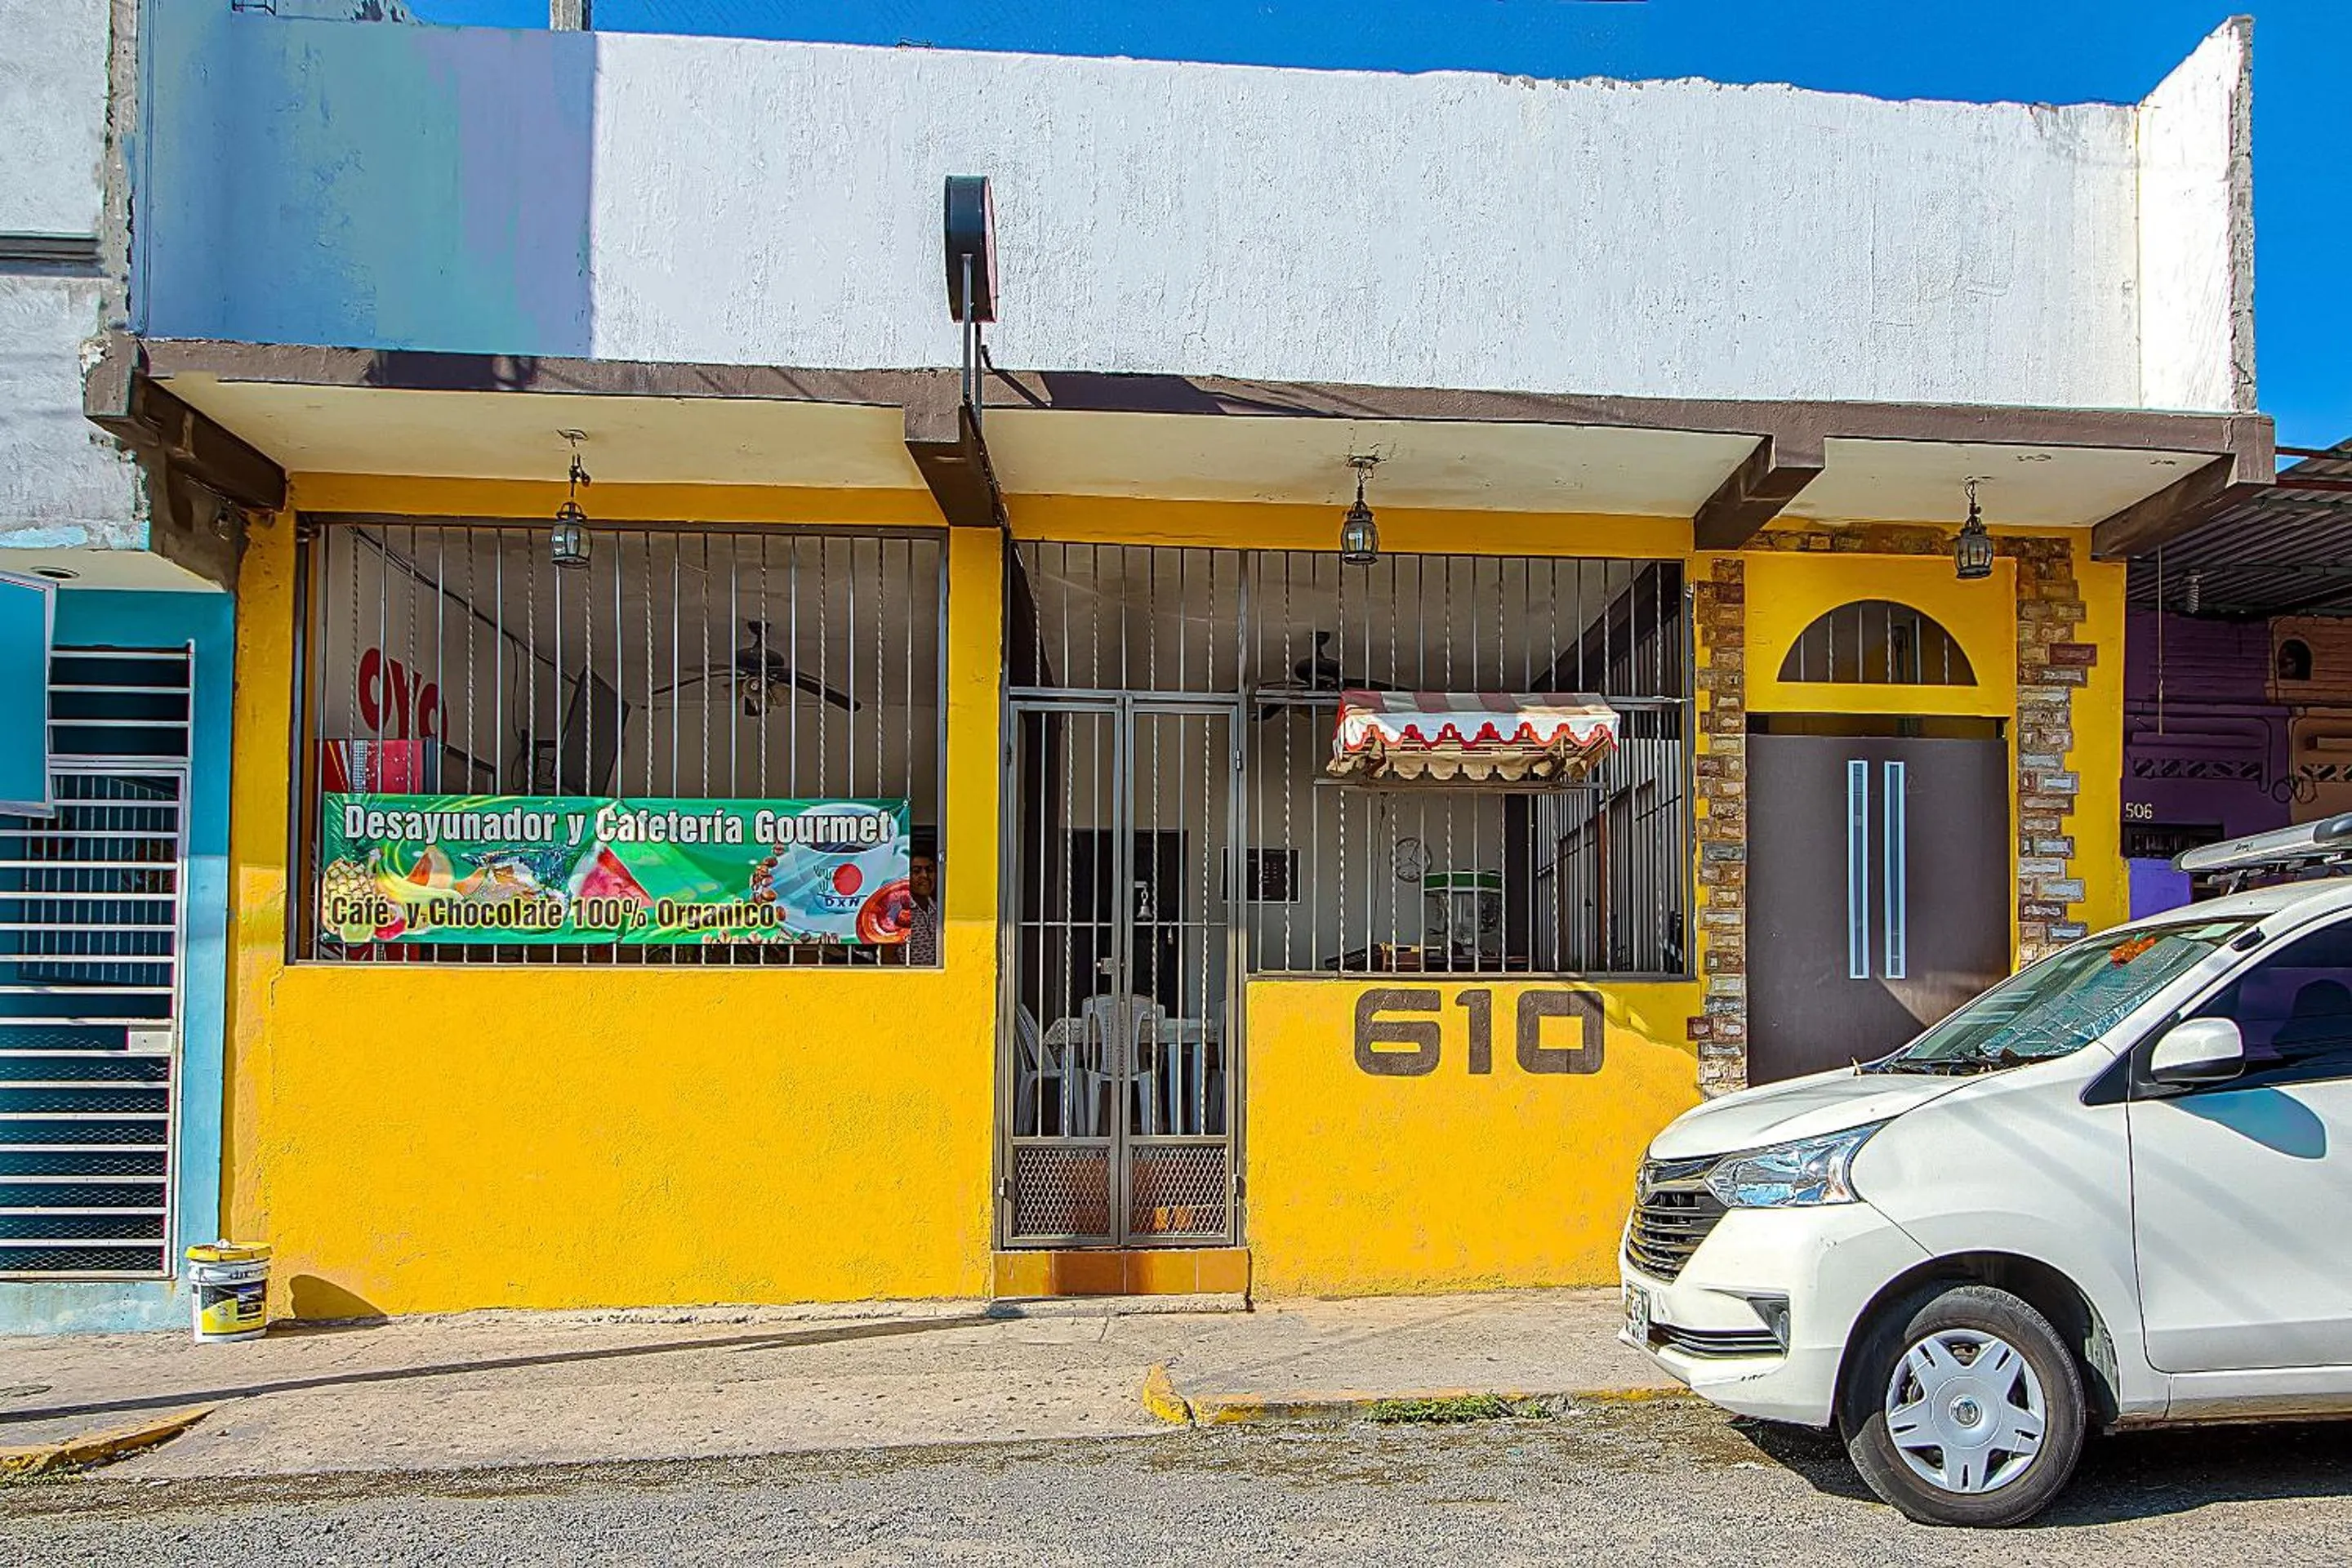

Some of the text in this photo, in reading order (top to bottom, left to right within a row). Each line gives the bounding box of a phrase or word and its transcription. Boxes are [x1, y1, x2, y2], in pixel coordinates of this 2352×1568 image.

[358, 647, 448, 745] OYO
[344, 804, 893, 846] Desayunador y Cafetería Gourmet
[2125, 802, 2153, 819] 506
[331, 894, 777, 931] Café y Chocolate 100% Organico
[825, 898, 860, 907] DXN
[1355, 988, 1605, 1076] 610
